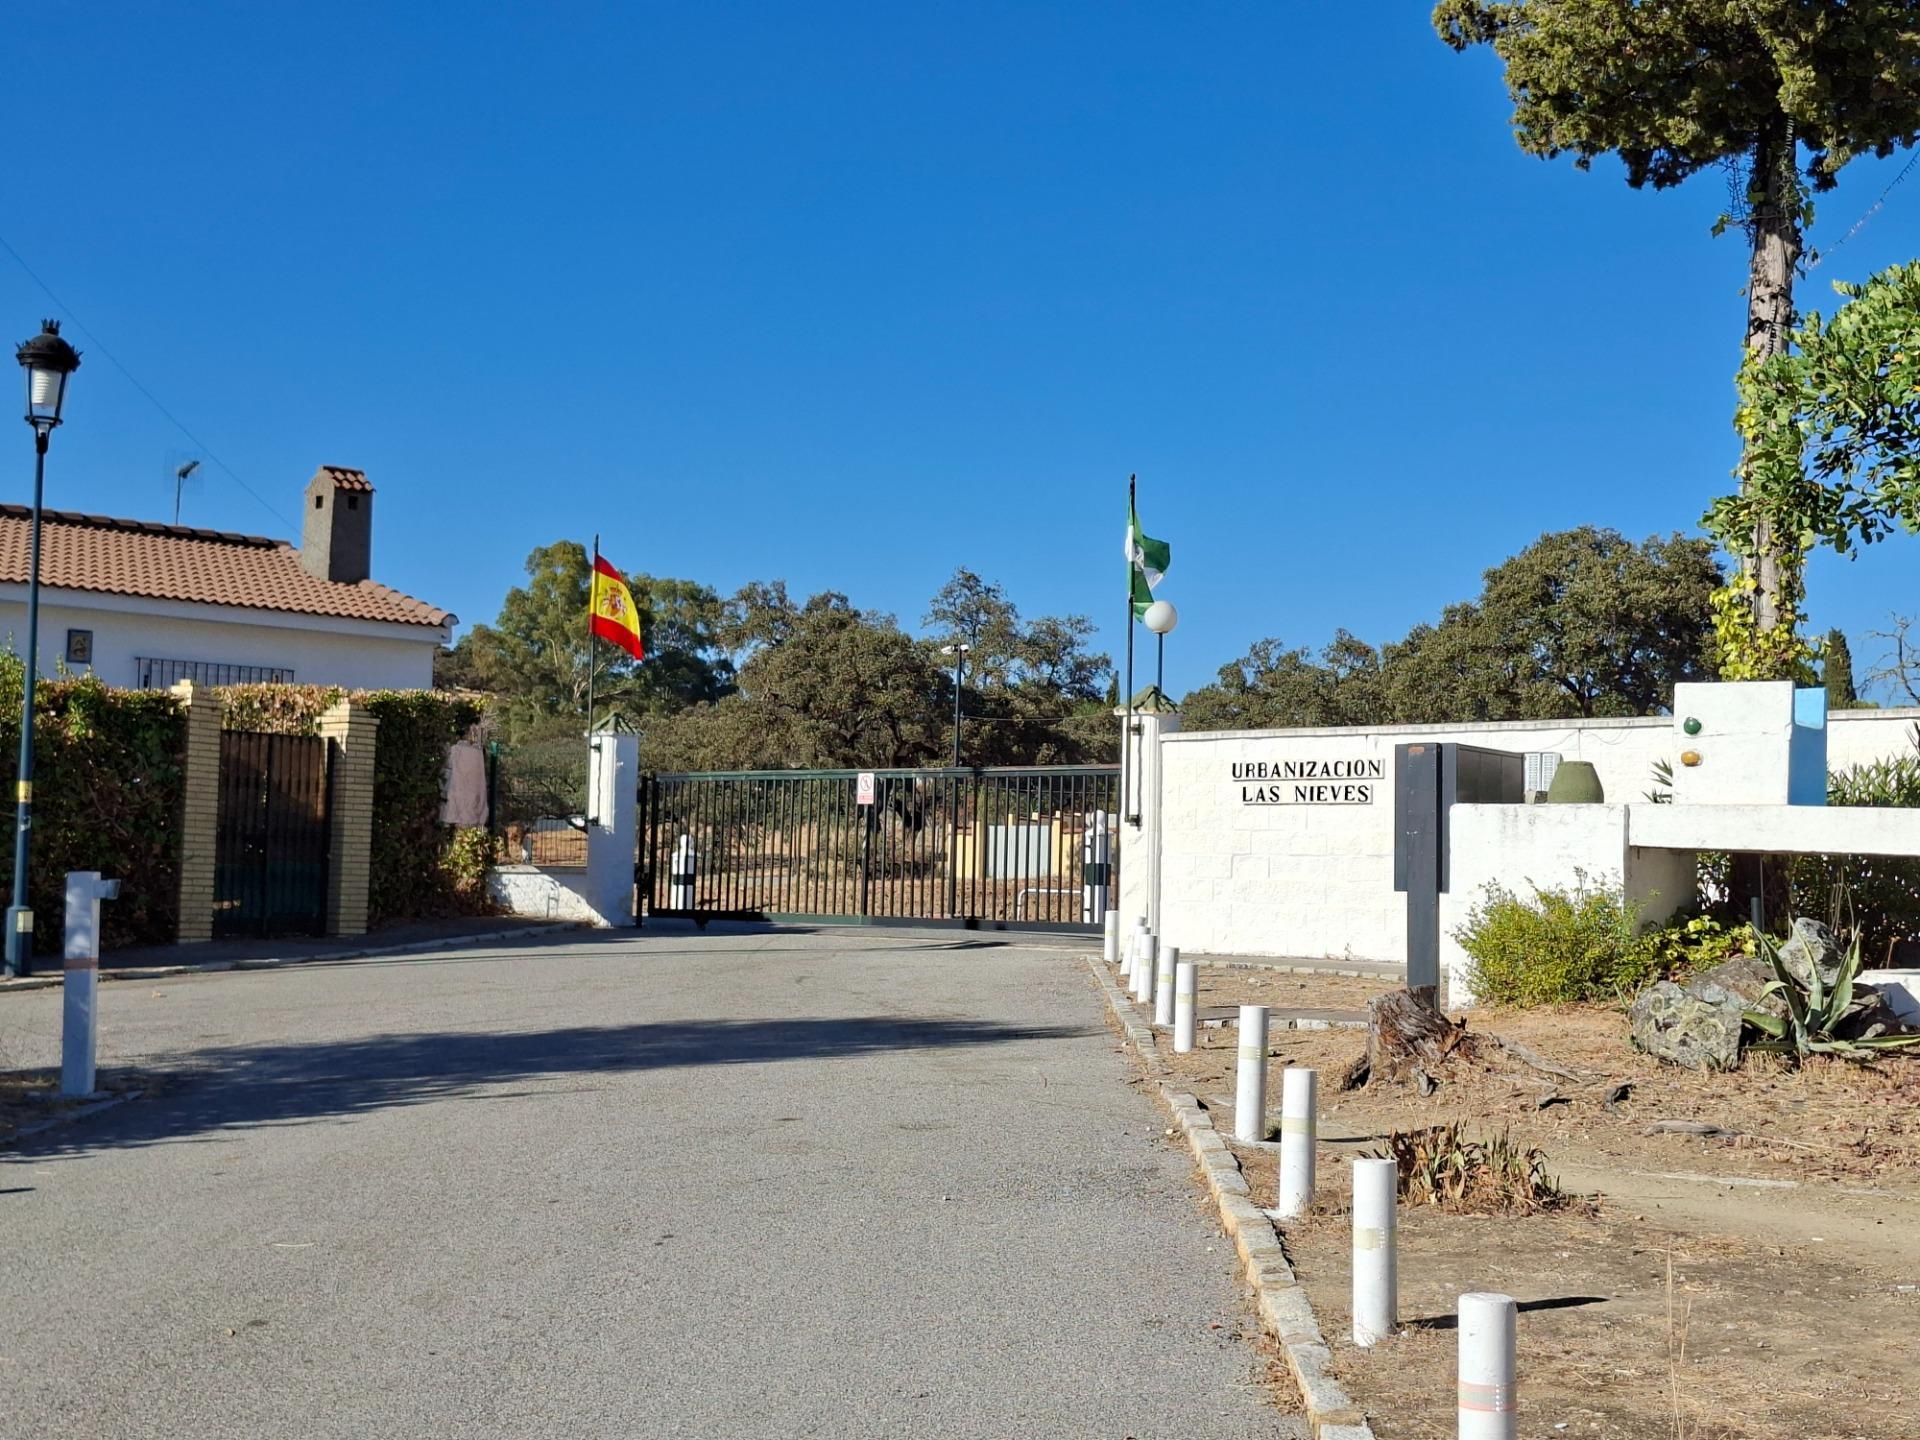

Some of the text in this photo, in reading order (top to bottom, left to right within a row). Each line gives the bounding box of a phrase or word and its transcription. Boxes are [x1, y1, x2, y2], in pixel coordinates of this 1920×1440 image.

[1232, 760, 1381, 778] URBANIZACION
[1242, 785, 1369, 802] LAS NIEVES
